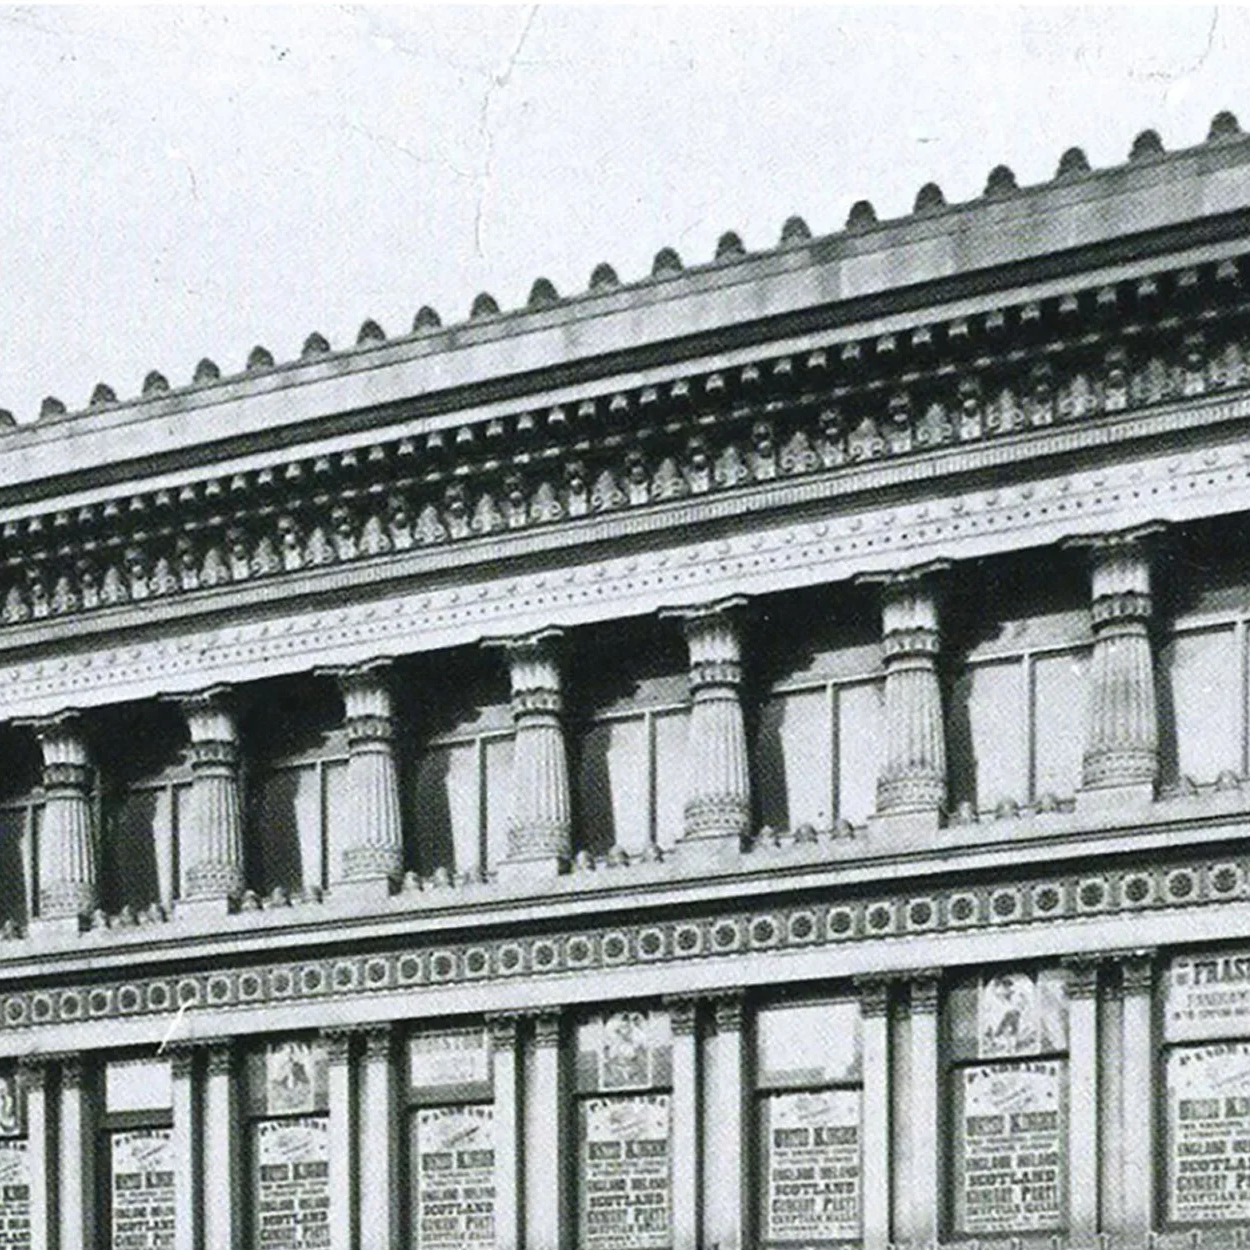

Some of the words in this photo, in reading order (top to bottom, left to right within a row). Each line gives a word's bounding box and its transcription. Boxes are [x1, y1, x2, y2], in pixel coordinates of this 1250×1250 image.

[969, 1169, 1056, 1187] SCOTLAND
[775, 1182, 855, 1196] SCOTLAND
[590, 1193, 664, 1207] SCOTLAND
